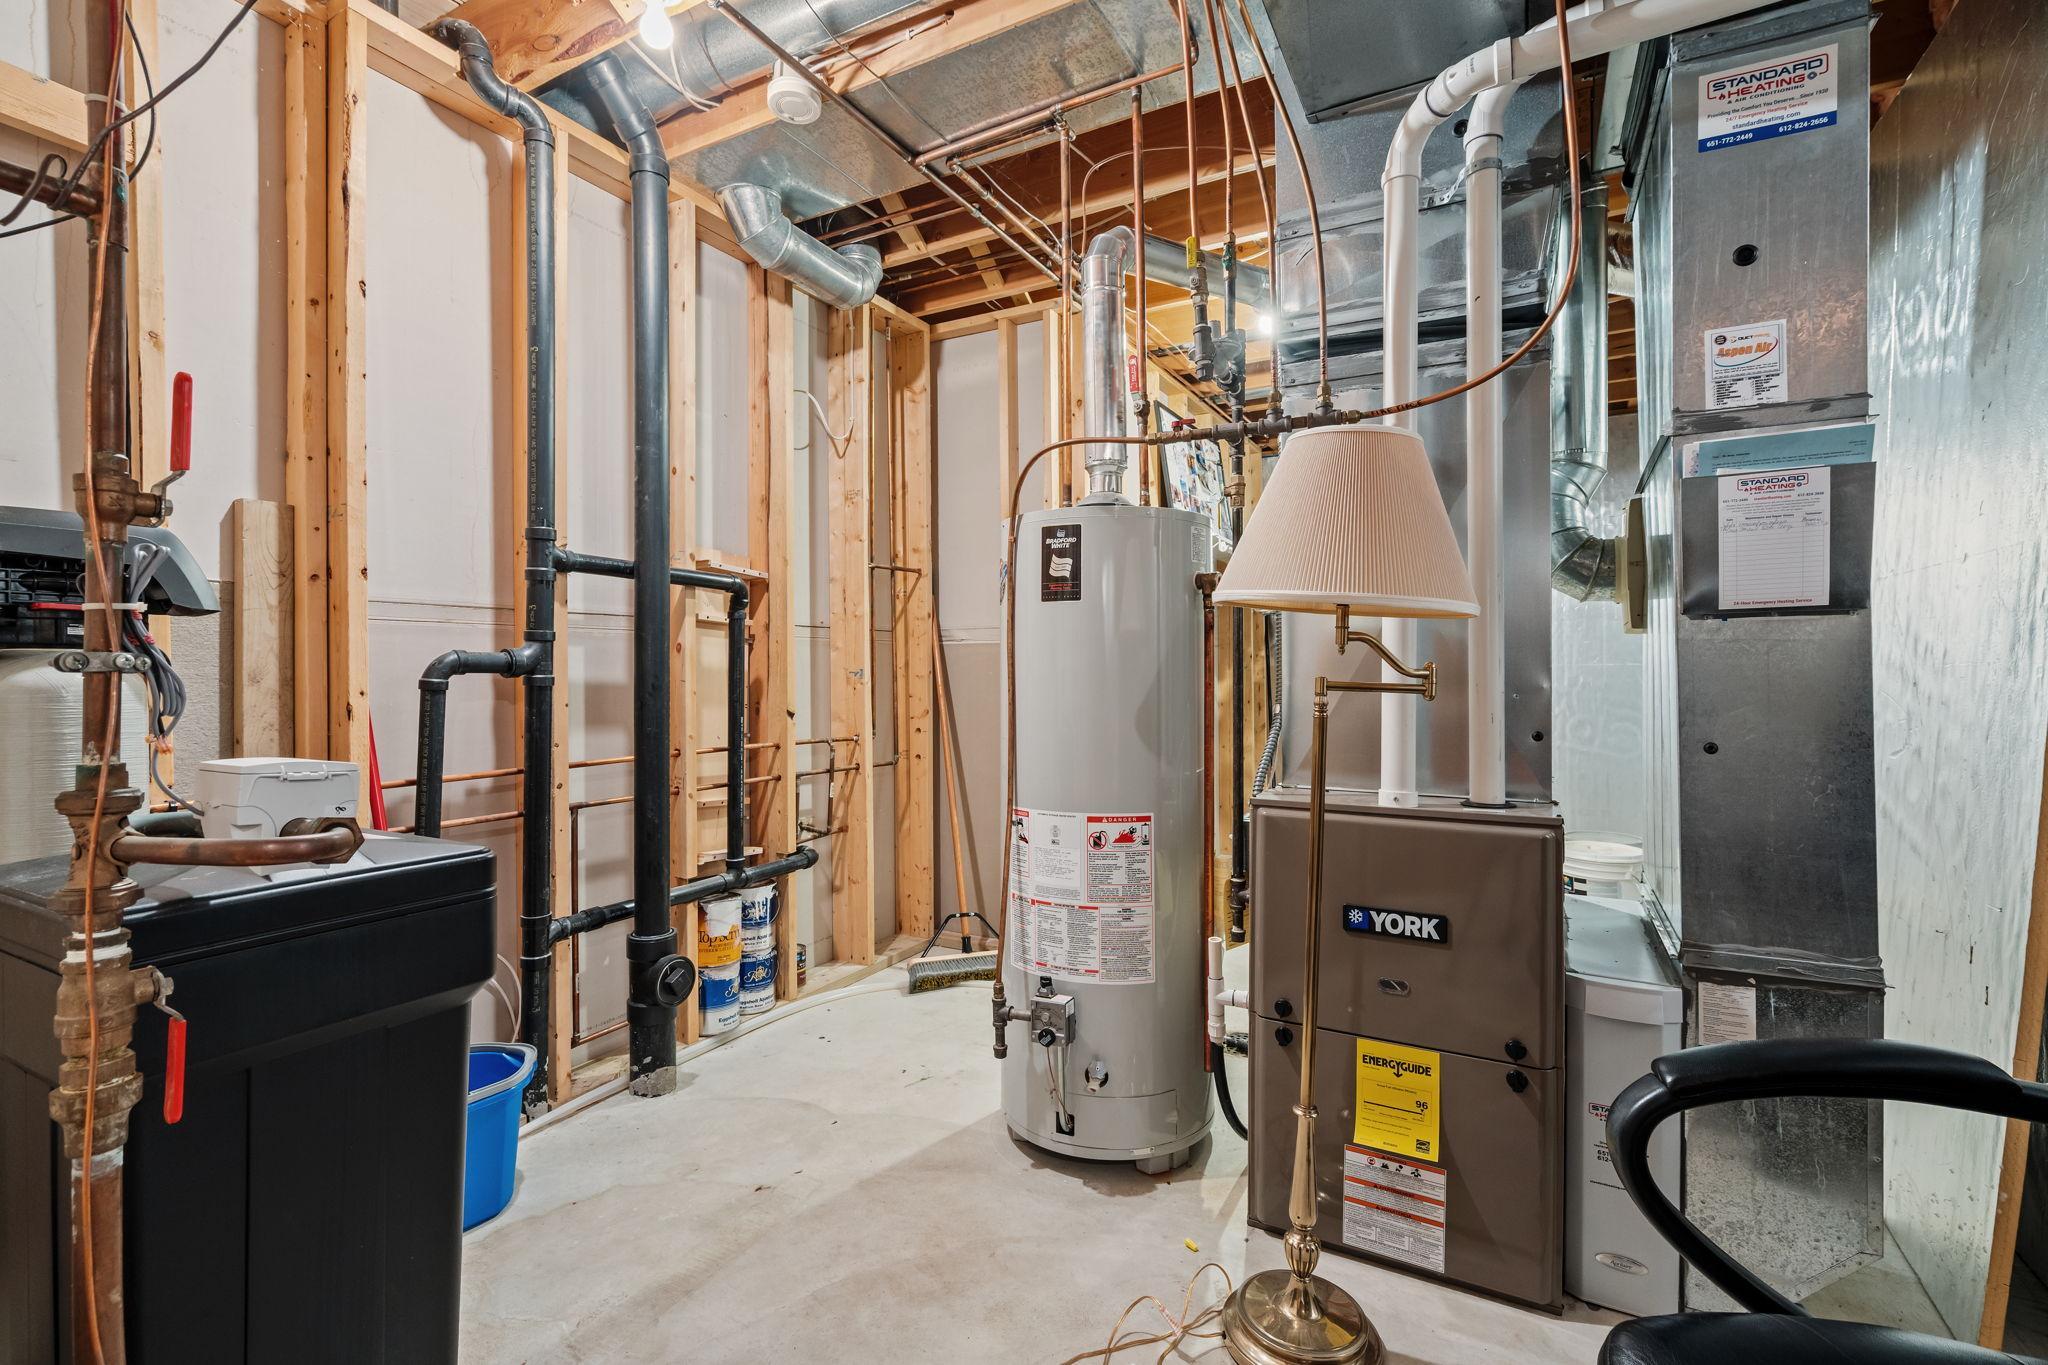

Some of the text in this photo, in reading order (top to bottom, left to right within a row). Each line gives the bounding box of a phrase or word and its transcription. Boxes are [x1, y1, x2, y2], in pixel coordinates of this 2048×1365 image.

[1712, 58, 1823, 92] STANDARD
[1727, 74, 1805, 99] HEATING
[1749, 84, 1805, 100] CONDITIONING
[1707, 110, 1731, 119] Providing
[1740, 103, 1762, 112] Comfort
[1738, 110, 1766, 120] Emergency
[1766, 105, 1788, 114] Heating
[1788, 101, 1808, 109] Service
[1732, 111, 1801, 130] standardheating.com
[1778, 116, 1829, 133] 612-824-2656
[1740, 475, 1806, 487] STANDARD
[1749, 483, 1795, 492] HEATING
[1369, 910, 1440, 940] YORK
[1362, 1054, 1432, 1078] ENERGYGUIDE
[1415, 1100, 1428, 1110] 96
